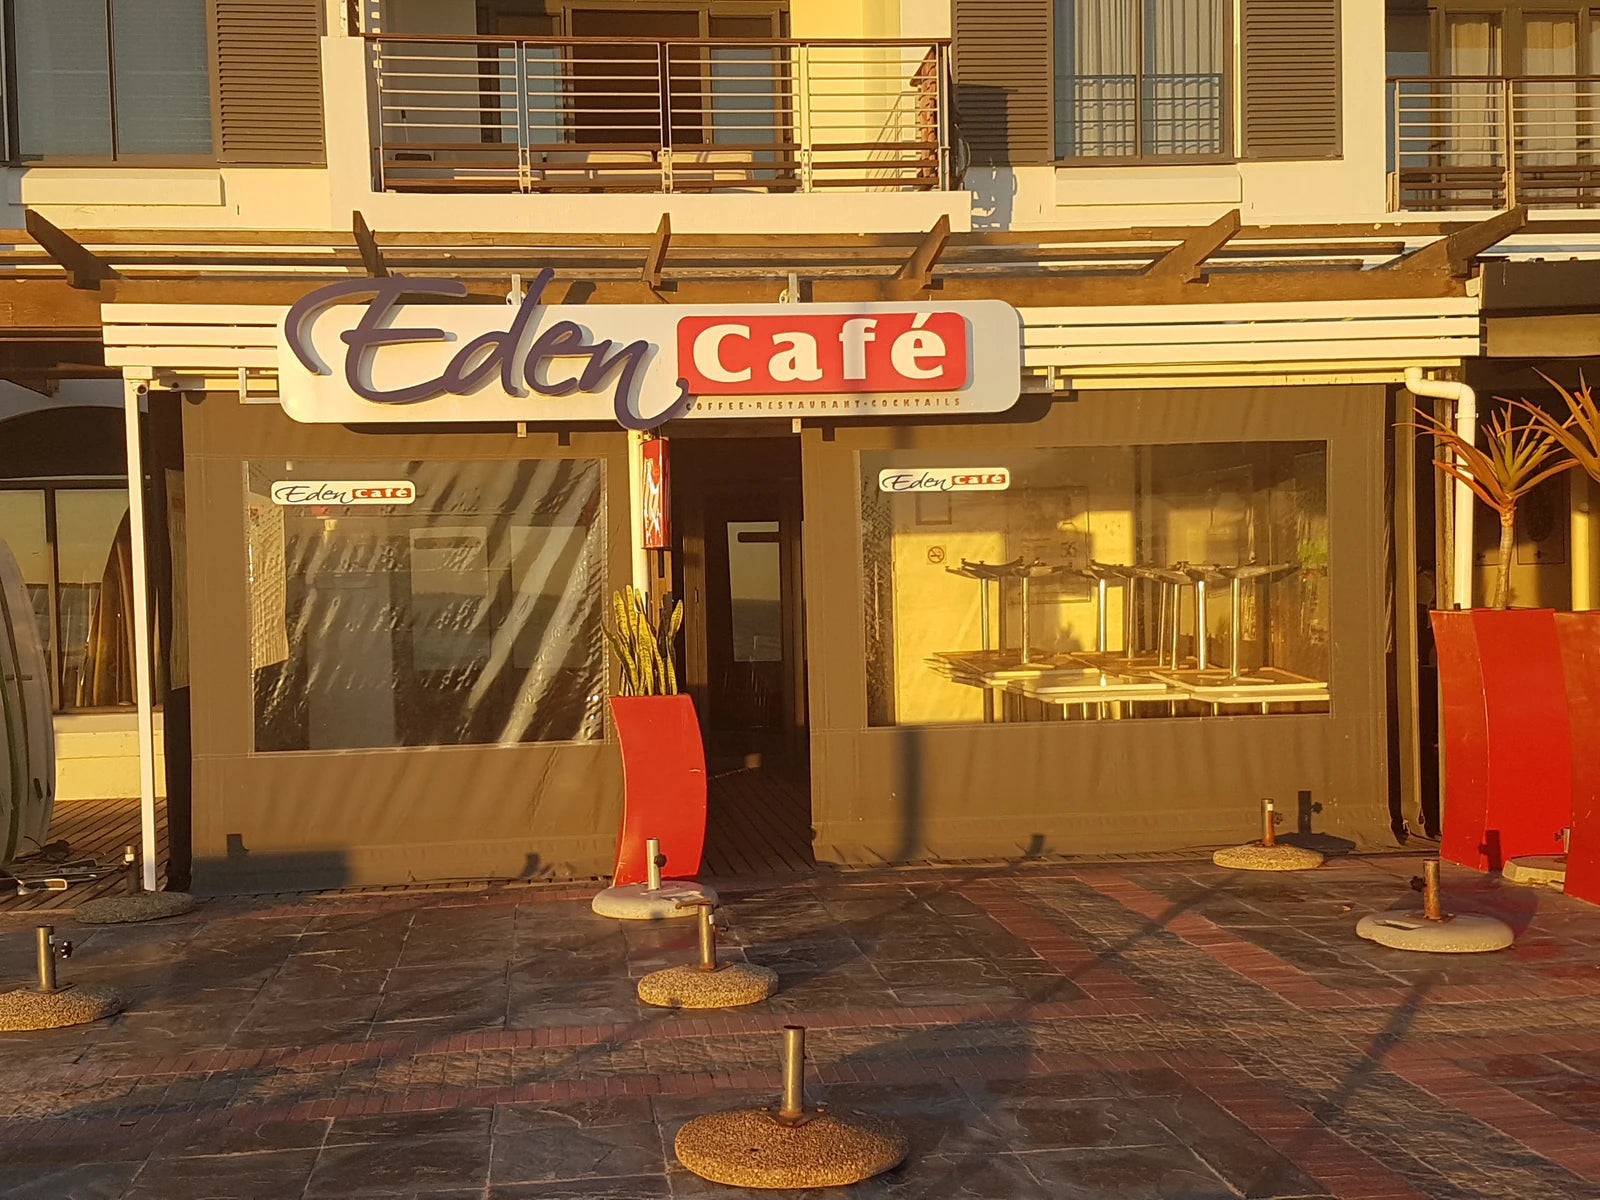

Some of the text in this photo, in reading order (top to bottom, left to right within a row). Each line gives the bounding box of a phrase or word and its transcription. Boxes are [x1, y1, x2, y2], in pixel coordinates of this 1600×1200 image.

[284, 267, 689, 429] Eden
[685, 397, 960, 411] COFFEE RESTAURANT COCKTAILS
[882, 472, 955, 491] Eden
[275, 483, 355, 504] Eden
